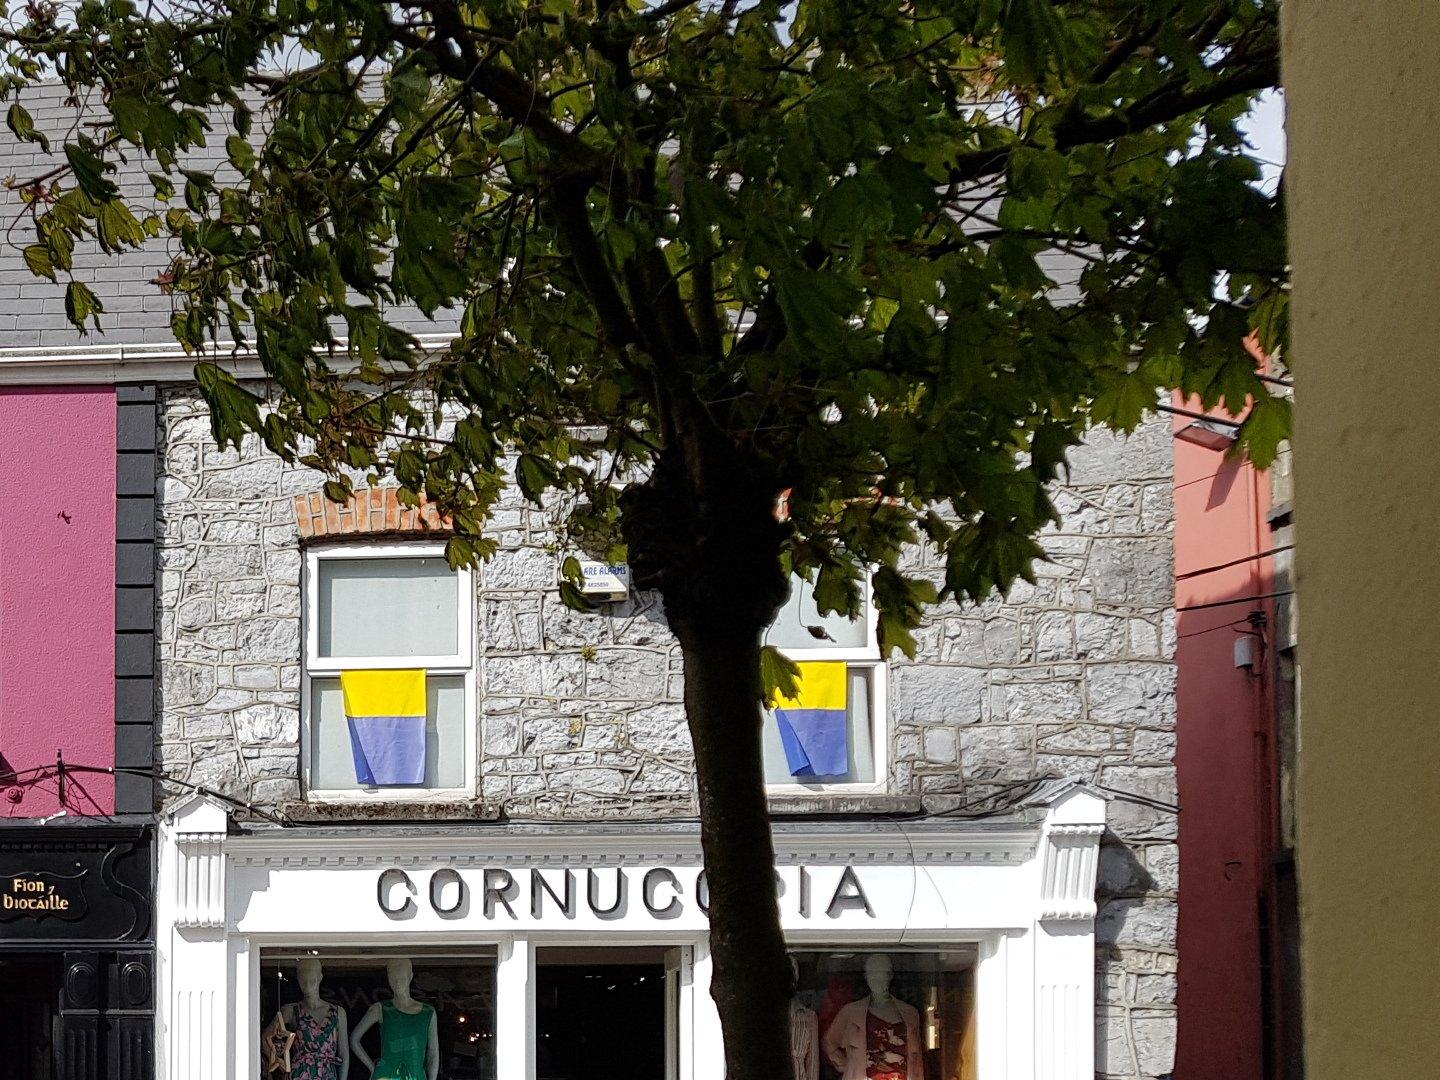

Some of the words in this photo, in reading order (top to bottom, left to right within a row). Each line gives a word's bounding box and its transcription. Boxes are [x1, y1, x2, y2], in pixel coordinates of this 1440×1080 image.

[583, 566, 598, 575] ARE
[599, 566, 626, 575] ALARMS
[376, 866, 876, 918] CORNUCIA
